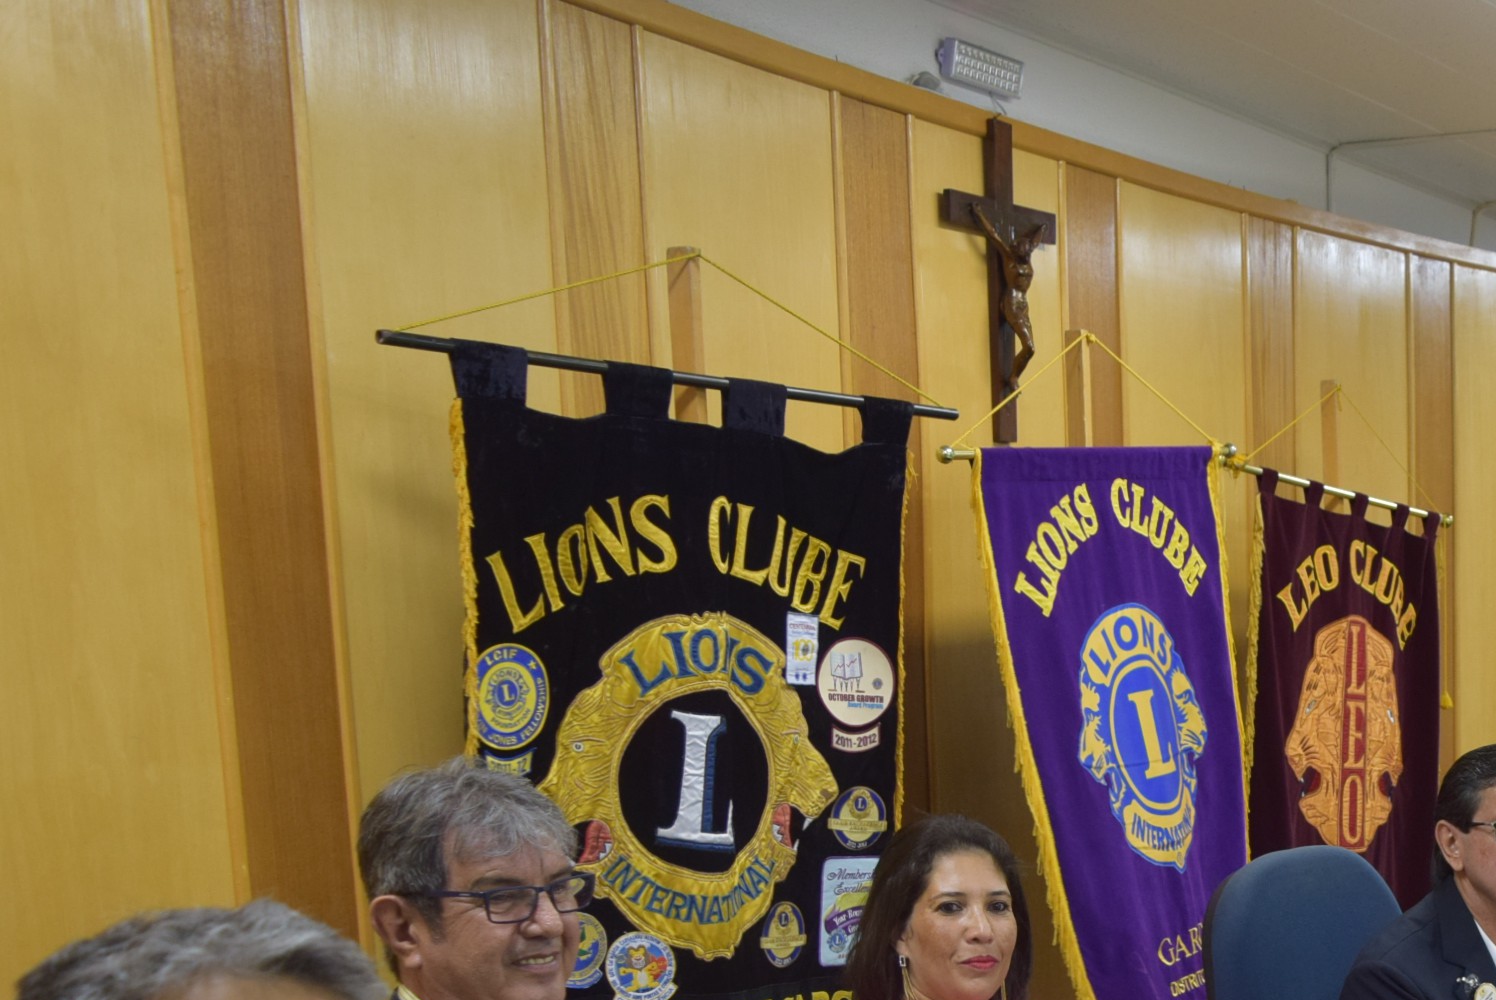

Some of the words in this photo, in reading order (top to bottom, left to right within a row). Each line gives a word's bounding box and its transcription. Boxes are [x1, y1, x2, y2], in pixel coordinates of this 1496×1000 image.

[486, 495, 678, 634] LIONS
[708, 495, 866, 631] CLUBE
[1014, 482, 1099, 617] LIONS
[1110, 477, 1208, 598] CLUBE
[1276, 543, 1340, 633] LEO
[485, 648, 518, 666] LCIF
[1088, 614, 1168, 678] LIONS
[501, 684, 515, 702] L
[520, 677, 547, 740] FELLOWSHIP
[828, 692, 856, 702] OCTOBER
[856, 694, 884, 704] GROWTH
[488, 733, 518, 746] JONES
[834, 733, 878, 749] 2011-2012
[1127, 689, 1177, 780] L
[1342, 624, 1366, 845] LEO
[656, 710, 736, 852] L
[601, 855, 777, 925] INTERNATIONAL
